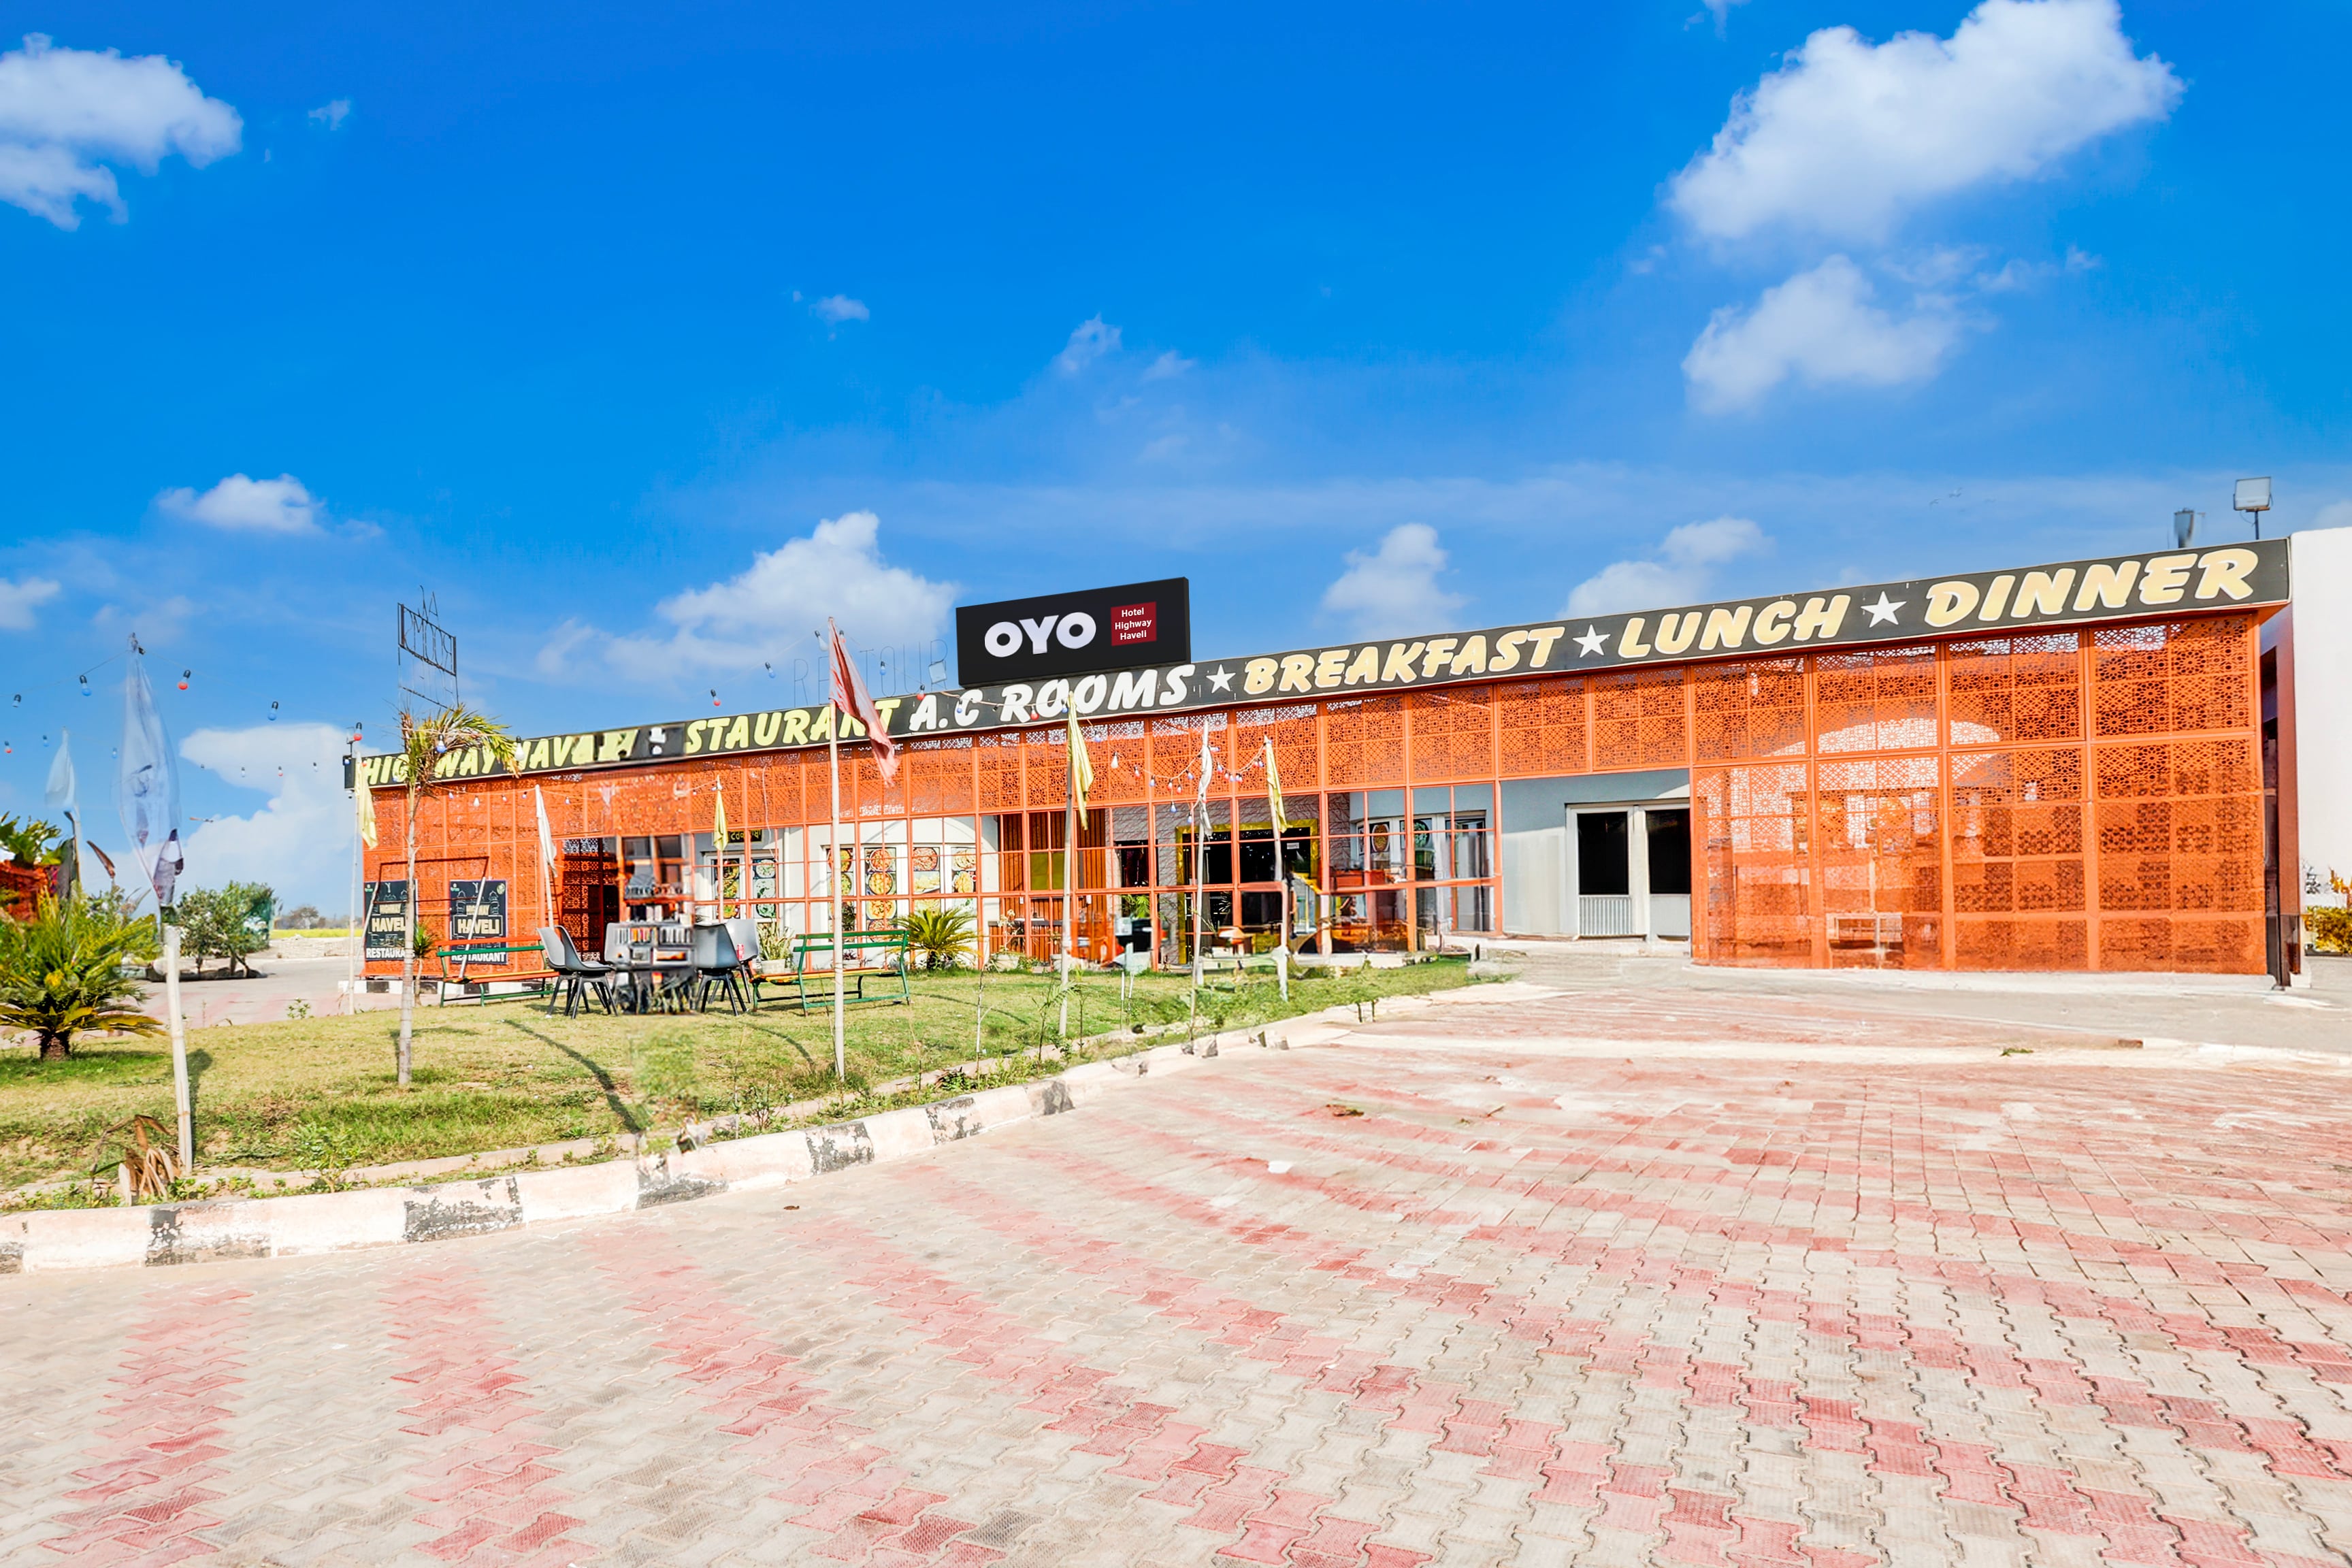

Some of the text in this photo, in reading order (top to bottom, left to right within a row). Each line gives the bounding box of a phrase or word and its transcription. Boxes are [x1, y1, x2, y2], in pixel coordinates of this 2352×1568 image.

[1121, 607, 1144, 617] Hotel
[1115, 619, 1152, 630] Highway
[984, 612, 1096, 657] OYO
[1120, 630, 1147, 640] Haveli
[365, 745, 497, 785] HIGWAY
[909, 689, 983, 731] A.C
[1000, 664, 1196, 723] ROOMS
[1243, 626, 1565, 695] BREAKFAST
[1618, 595, 1851, 659] LUNCH
[1924, 548, 2259, 627] DINNER
[372, 917, 406, 932] HAVEL
[457, 919, 500, 934] HAVELI
[366, 947, 415, 958] RESTAURA
[451, 951, 506, 962] RETAURANT
